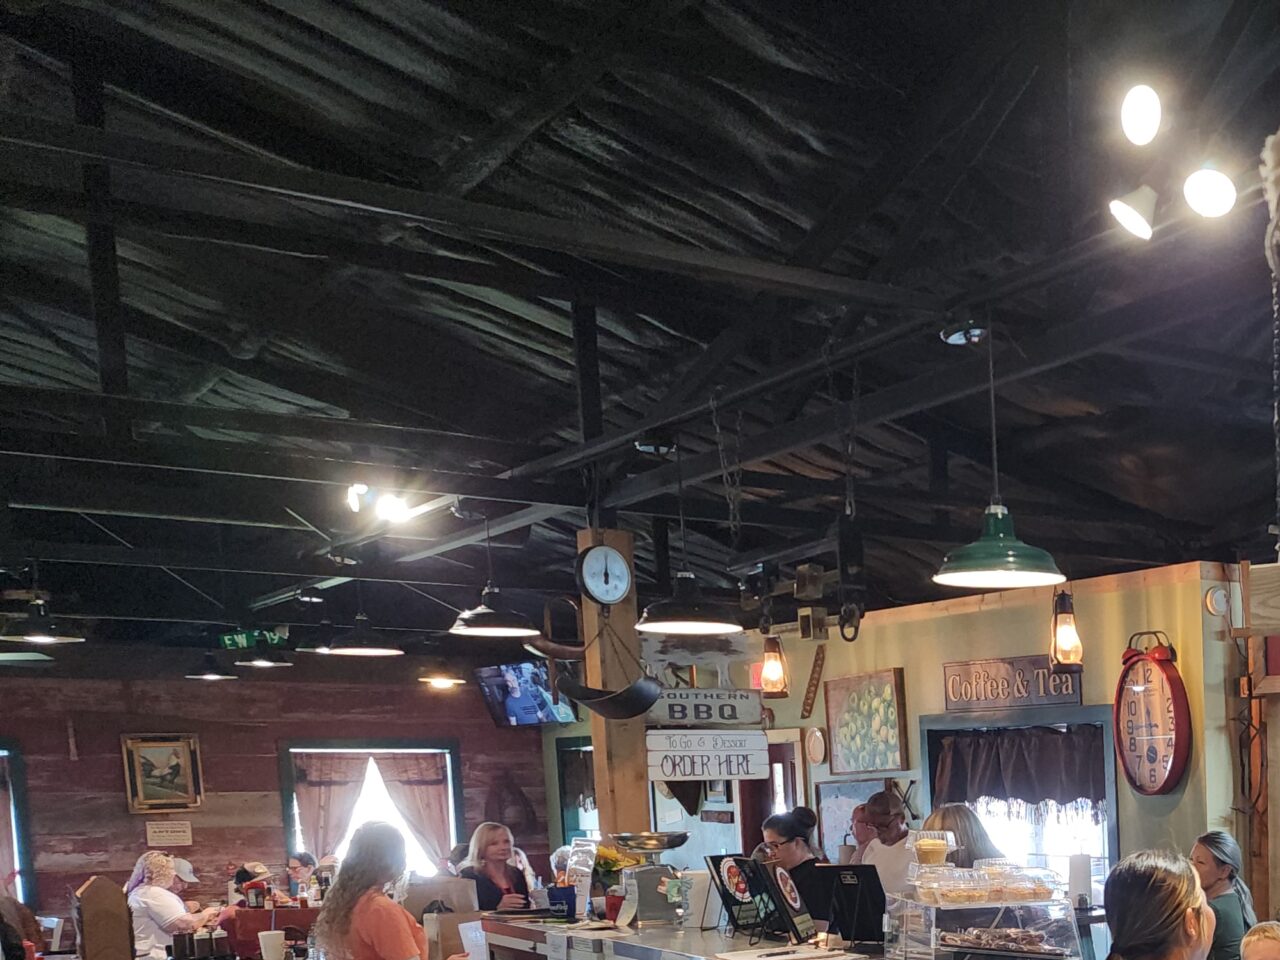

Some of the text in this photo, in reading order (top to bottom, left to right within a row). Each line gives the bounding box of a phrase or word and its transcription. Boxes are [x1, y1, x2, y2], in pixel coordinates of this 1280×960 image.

[1143, 668, 1152, 684] 12
[948, 668, 1074, 702] Coffee & Tea
[658, 692, 750, 701] SOUTHERN
[668, 703, 739, 720] BBQ
[1127, 700, 1136, 716] 10
[1166, 697, 1173, 713] 2
[1126, 719, 1134, 735] 9
[1168, 716, 1175, 732] 3
[665, 735, 678, 748] To
[680, 735, 693, 749] Go
[1129, 737, 1137, 753] 8
[661, 753, 756, 778] ORDER HERE
[1135, 754, 1143, 771] 7
[1161, 754, 1169, 770] 5
[1149, 768, 1157, 784] 6
